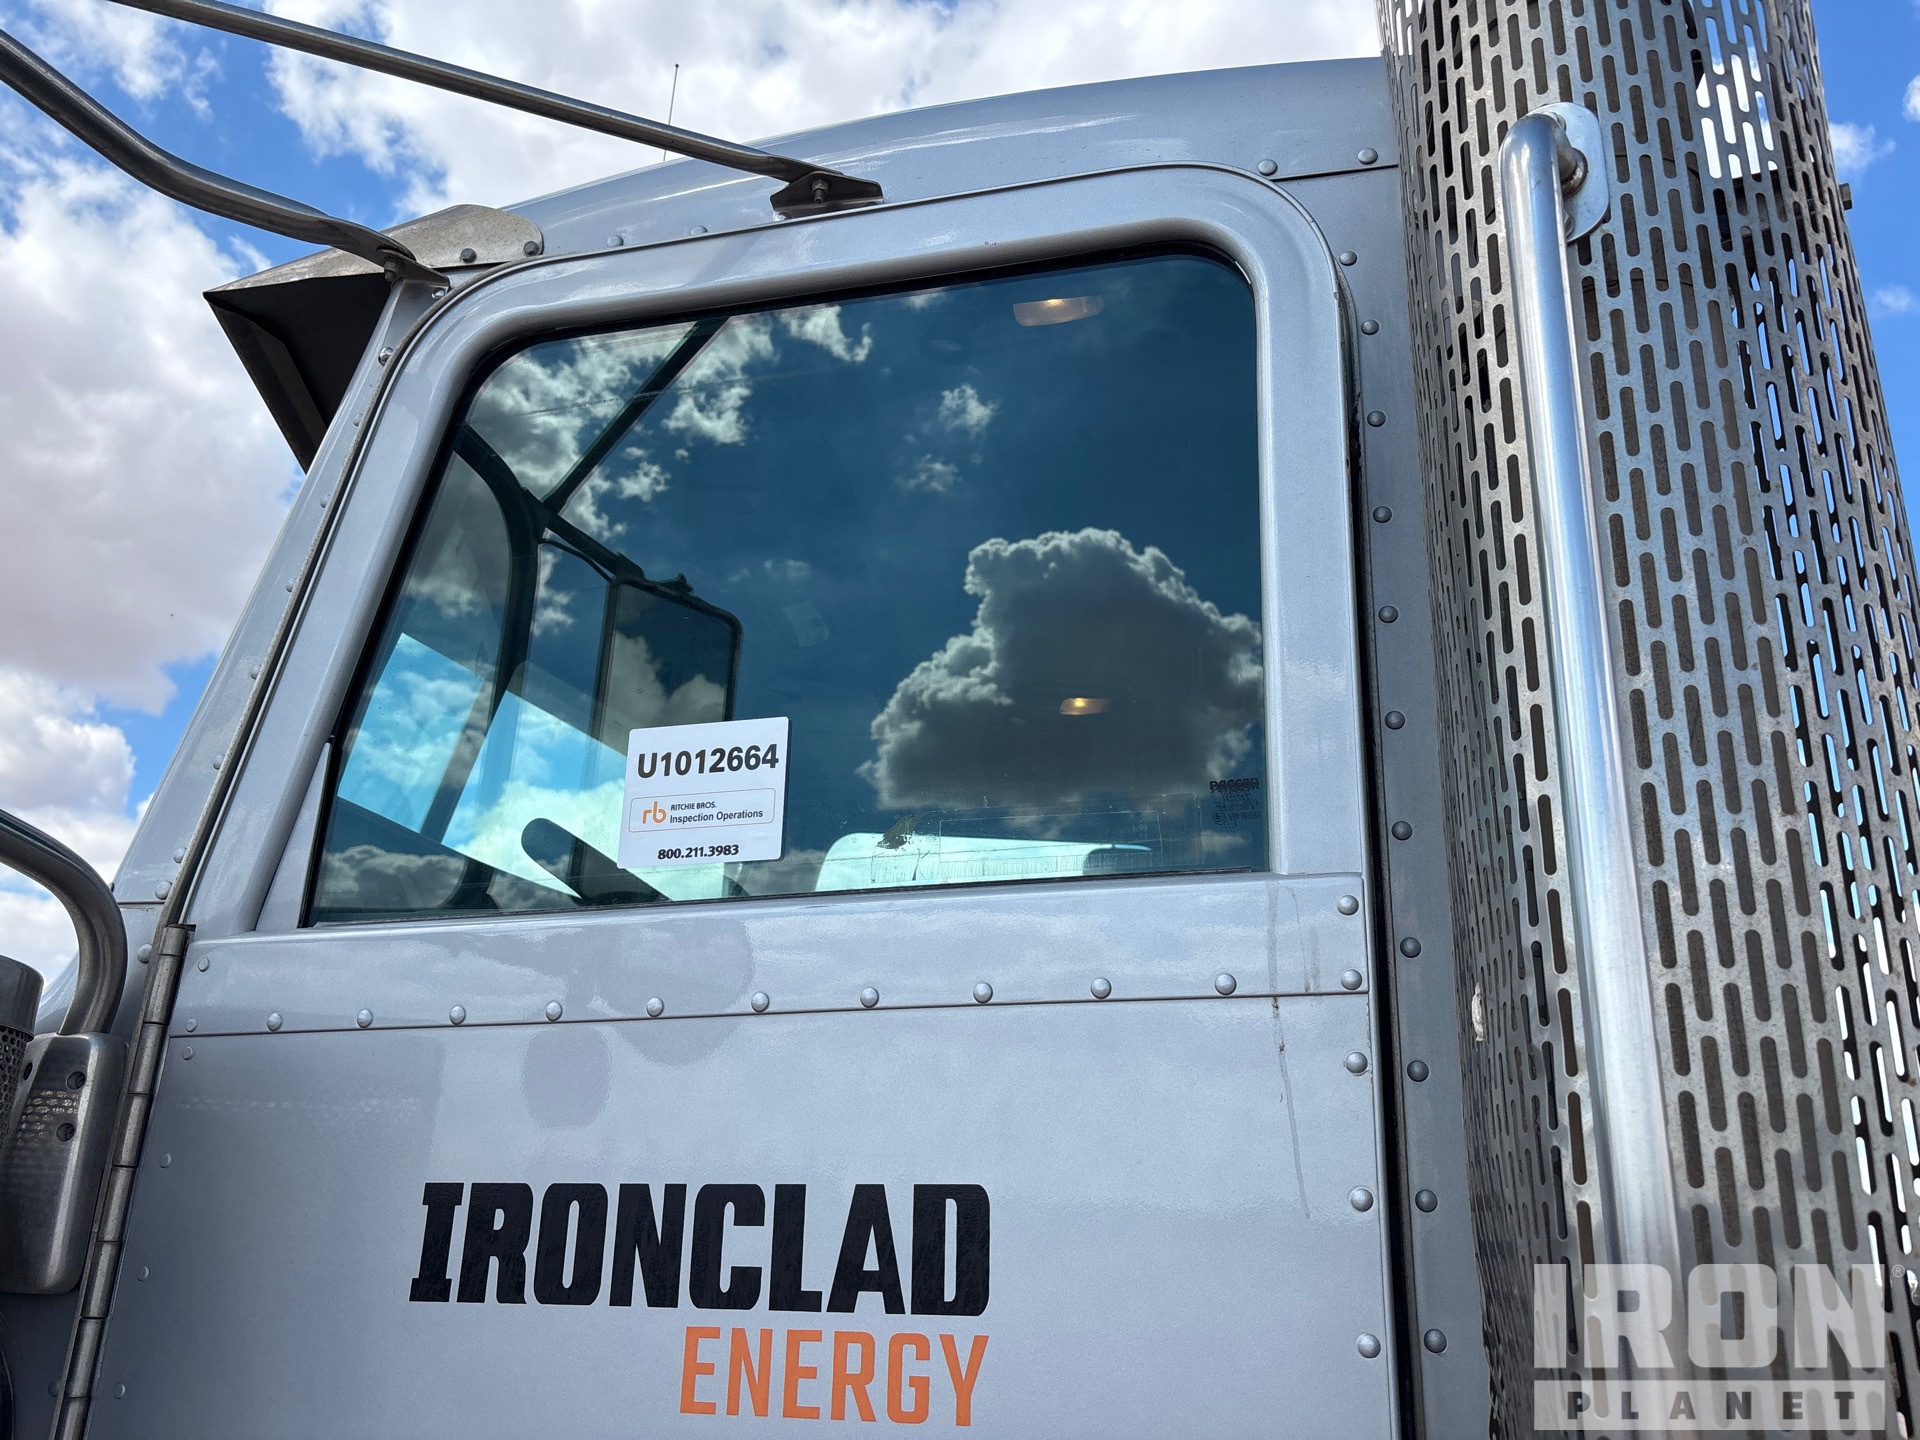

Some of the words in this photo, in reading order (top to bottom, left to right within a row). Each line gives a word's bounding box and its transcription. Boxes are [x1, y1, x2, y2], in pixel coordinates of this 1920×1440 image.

[637, 743, 779, 778] U1012664
[642, 801, 667, 824] rb
[669, 812, 714, 824] Inspection
[716, 809, 763, 821] Operations
[670, 802, 695, 811] RITCHIE
[696, 801, 717, 810] BROS.
[657, 844, 739, 860] 800.211.3983
[409, 1182, 990, 1316] IRONCLAD
[679, 1326, 989, 1426] ENERGY
